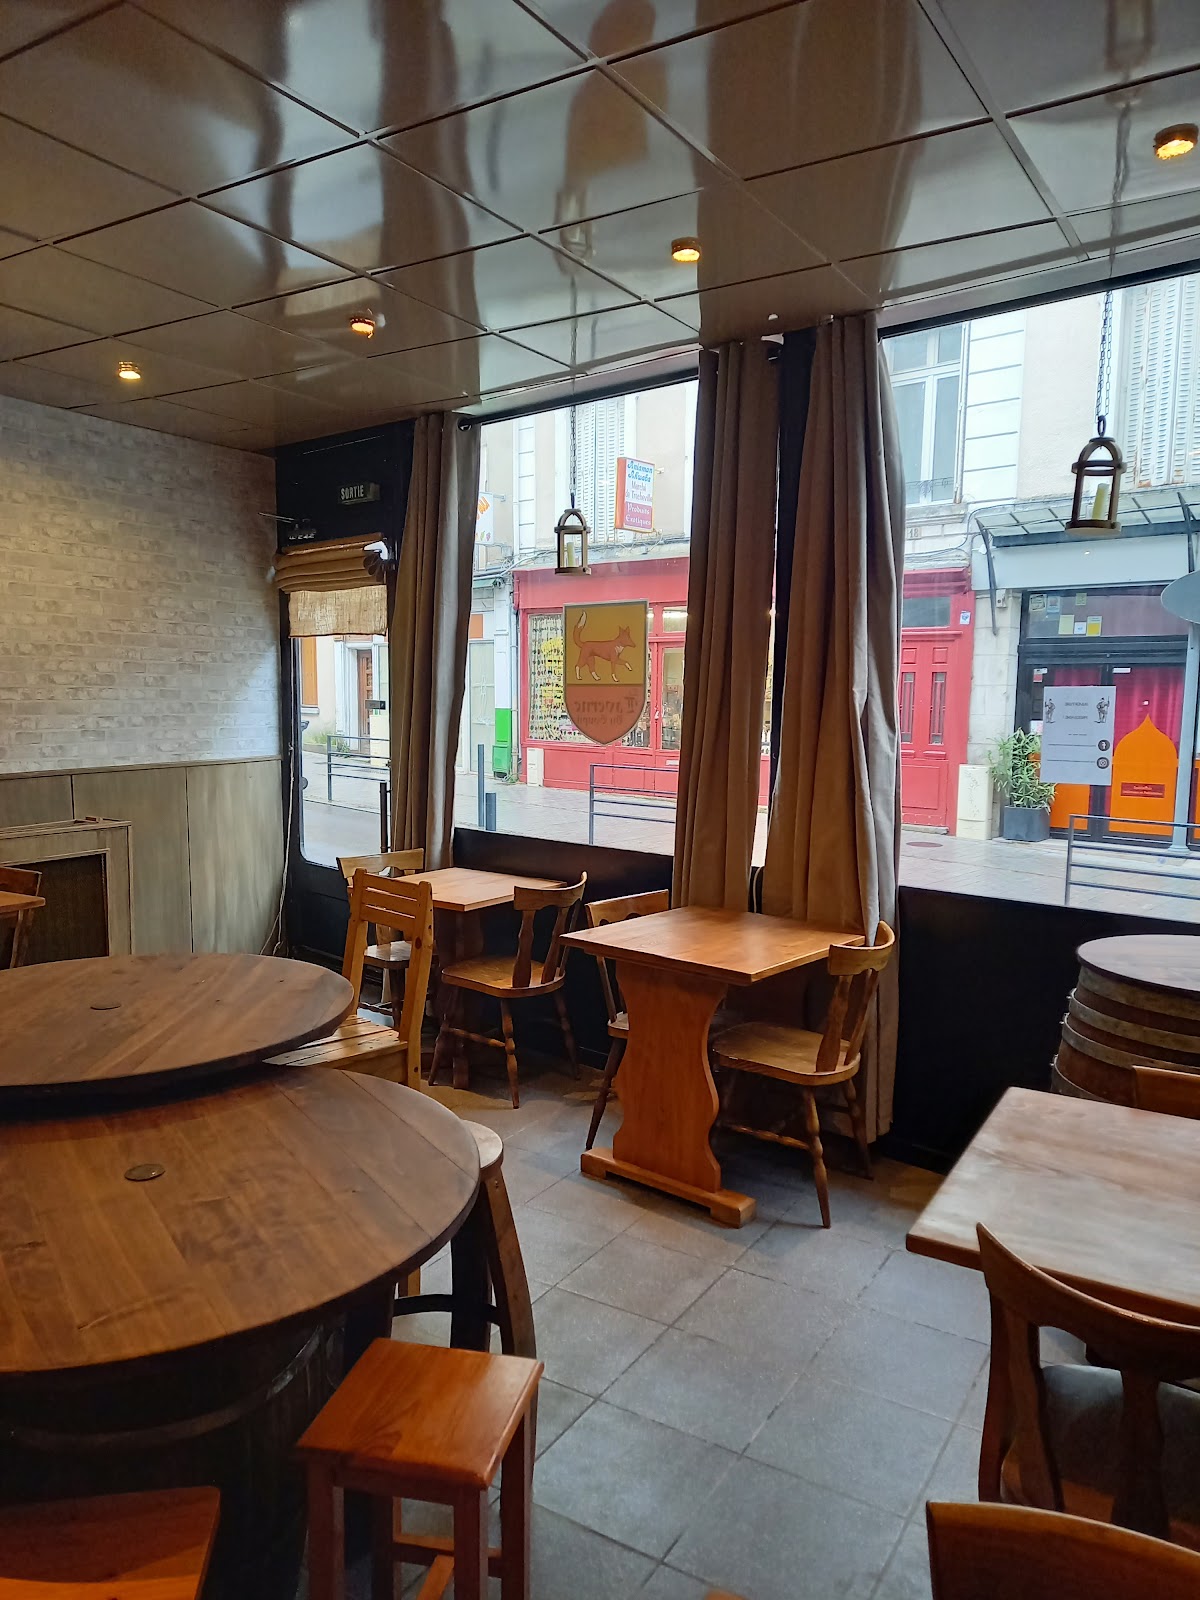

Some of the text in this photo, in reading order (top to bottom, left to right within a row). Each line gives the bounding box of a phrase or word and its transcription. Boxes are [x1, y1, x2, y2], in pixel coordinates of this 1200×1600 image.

[340, 485, 364, 500] SORTIE
[627, 502, 650, 515] Produits
[625, 513, 651, 526] Exotiques
